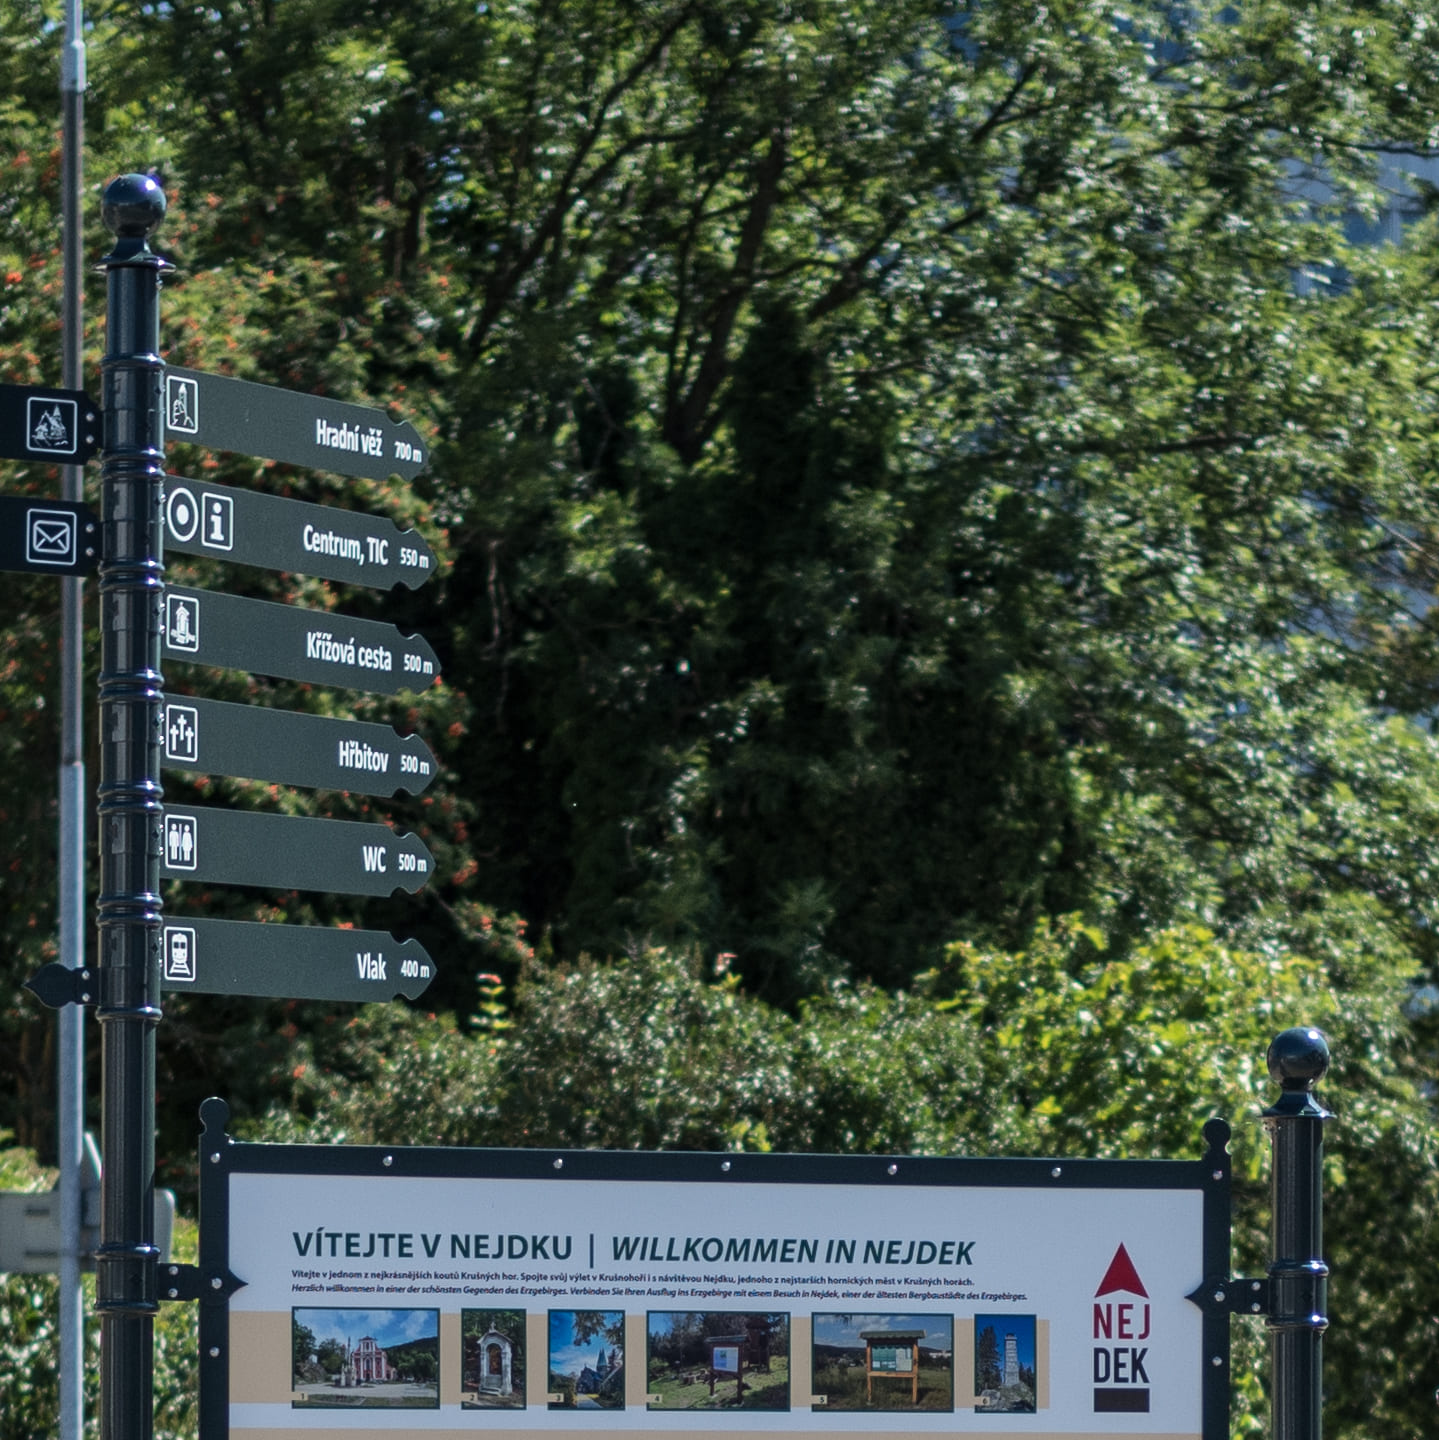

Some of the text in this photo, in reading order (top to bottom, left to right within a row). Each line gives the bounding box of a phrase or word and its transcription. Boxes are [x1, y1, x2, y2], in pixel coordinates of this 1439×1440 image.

[316, 418, 422, 463] Hradní věž 700 m
[303, 524, 429, 569] Centrum, TIC 550 m
[307, 631, 433, 674] Křížová cesta 500 m
[339, 740, 430, 775] Hřbitov 500 m
[363, 846, 427, 873] WC 500 m
[357, 952, 430, 981] Vlak 400 m
[292, 1227, 976, 1266] VÍTEJTE V NEJDKU WILLKOMMEN IN NEJDEK
[292, 1270, 320, 1281] Vítejte
[328, 1270, 362, 1282] jednom
[461, 1272, 500, 1283] Krušných
[521, 1272, 548, 1283] Spojte
[570, 1272, 590, 1284] výlet
[738, 1274, 772, 1285] jednoho
[876, 1275, 895, 1284] měst
[904, 1275, 942, 1287] Krušných
[1094, 1303, 1150, 1340] NEJ
[1094, 1347, 1150, 1384] DEK
